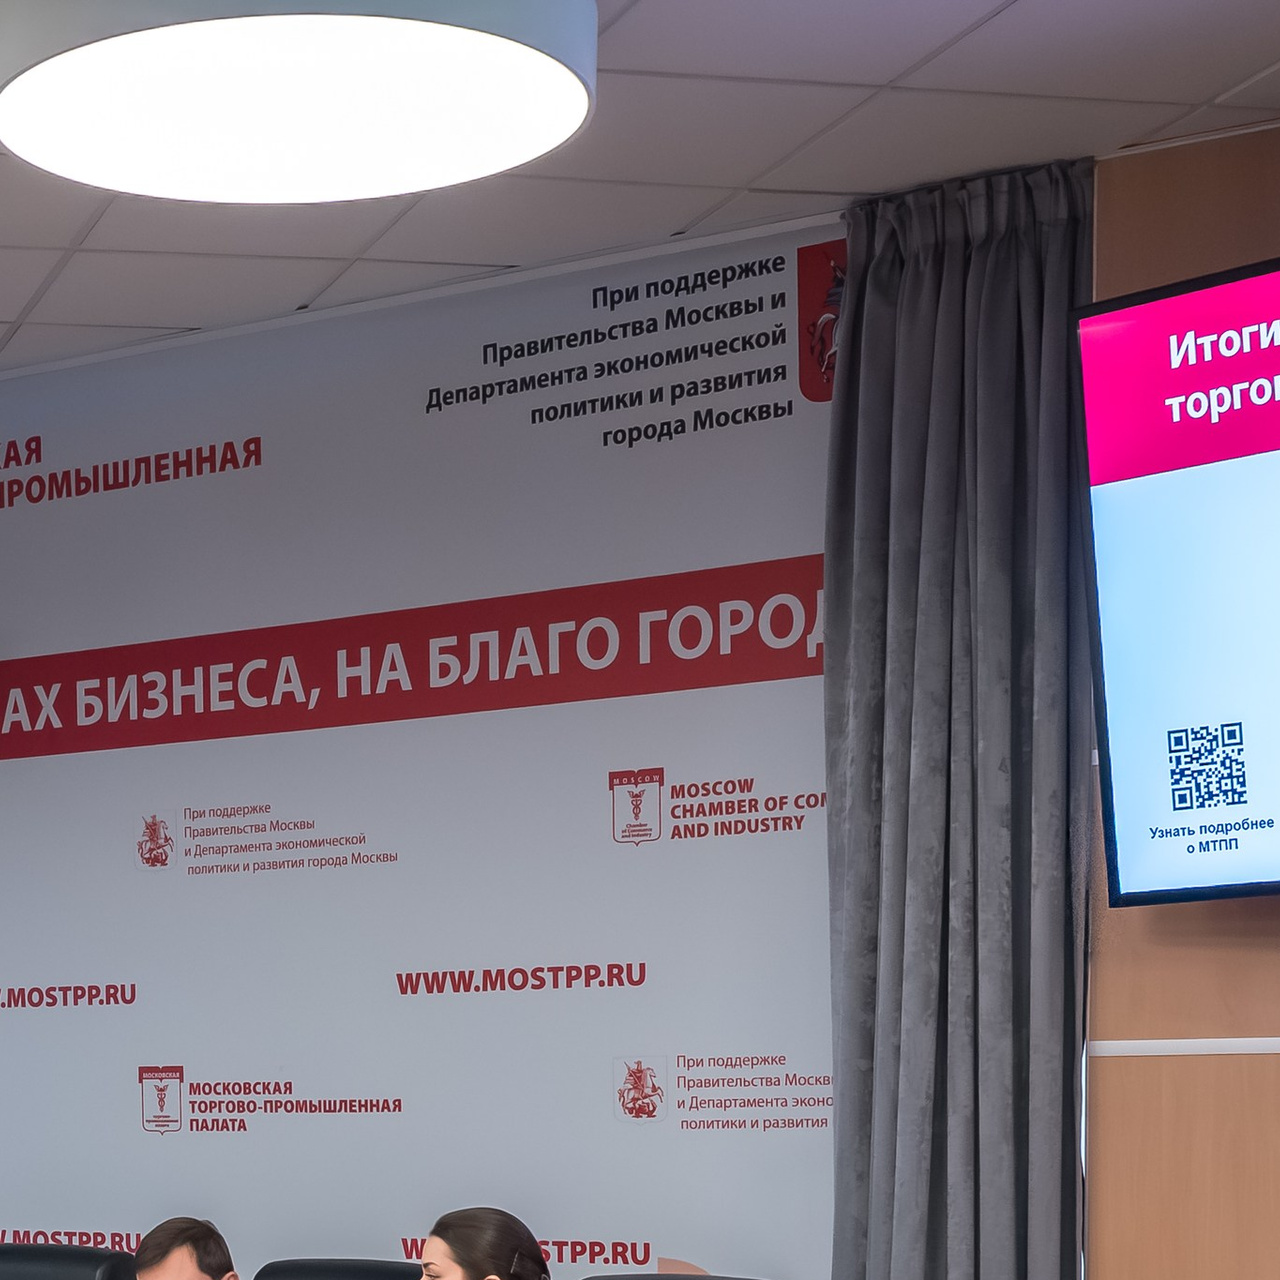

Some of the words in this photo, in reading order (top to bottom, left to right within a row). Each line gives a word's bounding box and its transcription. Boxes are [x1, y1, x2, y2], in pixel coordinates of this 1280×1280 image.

[591, 285, 639, 312] При
[645, 254, 786, 301] поддержке
[482, 317, 659, 367] Правительства
[664, 294, 764, 331] Москвы
[771, 291, 787, 311] и
[1169, 319, 1280, 369] Итоги
[425, 364, 588, 414] Департамента
[593, 322, 787, 380] экономической
[530, 390, 644, 425] политики
[649, 386, 664, 404] и
[670, 364, 787, 406] развития
[602, 417, 686, 448] города
[692, 399, 794, 432] Москвы
[76, 655, 321, 728] БИЗНЕСА,
[336, 642, 413, 698] НА
[429, 616, 620, 689] БЛАГО
[613, 774, 660, 785] MOSCOW
[670, 778, 755, 799] MOSCOW
[183, 807, 206, 822] При
[208, 803, 271, 820] поддержке
[670, 798, 759, 820] CHAMBER
[764, 795, 788, 812] OF
[184, 824, 267, 840] Правительства
[270, 819, 315, 832] Москвы
[670, 821, 710, 840] AND
[714, 815, 806, 837] INDUSTRY
[1149, 827, 1195, 839] Узнать
[1199, 818, 1275, 835] подробнее
[184, 848, 191, 857] и
[194, 842, 272, 858] Департамента
[275, 832, 366, 851] экономической
[1186, 844, 1195, 854] о
[1199, 838, 1239, 853] МТПП
[187, 863, 240, 875] политики
[242, 862, 250, 871] и
[252, 859, 304, 874] развития
[307, 856, 348, 870] города
[351, 851, 398, 865] Москвы
[395, 962, 647, 996] WWW.MOSTPP.RU
[676, 1055, 704, 1071] При
[708, 1055, 787, 1069] поддержке
[189, 1081, 293, 1096] МОСКОВСКАЯ
[677, 1075, 781, 1091] Правительства
[784, 1073, 833, 1087] Москв
[189, 1098, 402, 1114] ТОРГОВО-ПРОМЫШЛЕННАЯ
[677, 1099, 685, 1109] и
[688, 1096, 788, 1111] Департамента
[189, 1118, 248, 1132] ПАЛАТА
[680, 1118, 747, 1130] политики
[750, 1118, 759, 1129] и
[763, 1117, 828, 1132] развития
